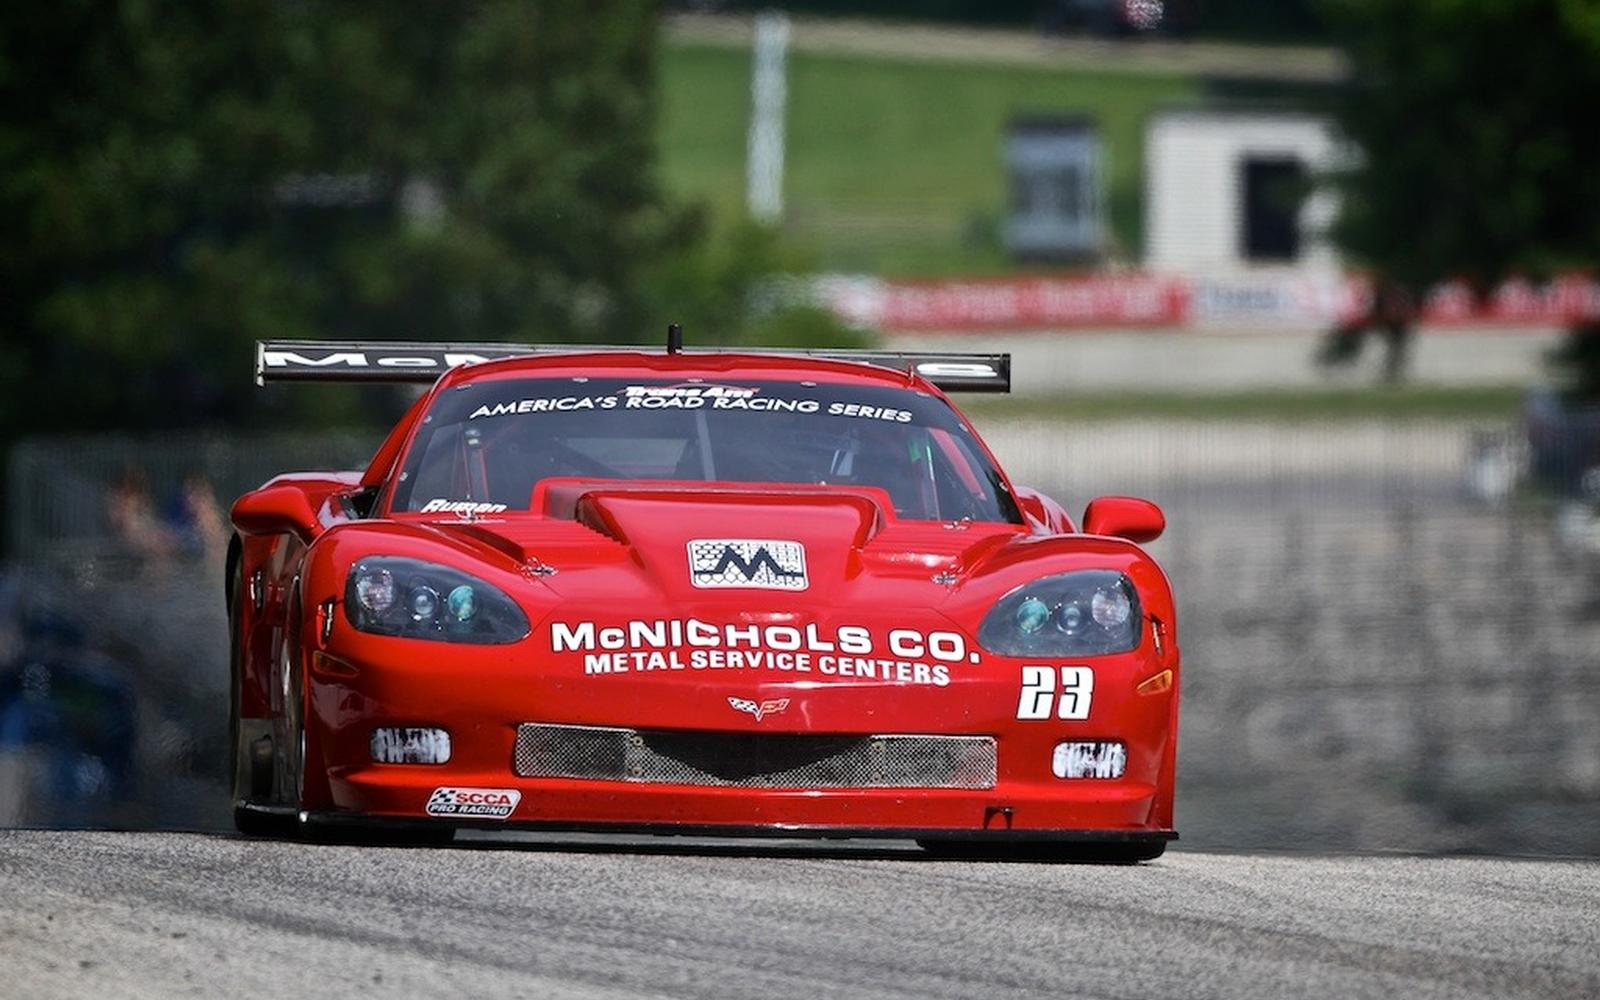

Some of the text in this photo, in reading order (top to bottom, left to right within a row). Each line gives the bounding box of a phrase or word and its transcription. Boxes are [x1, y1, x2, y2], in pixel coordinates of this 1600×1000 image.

[470, 396, 913, 422] AMERICA'S ROAD RACING SERIES
[551, 618, 980, 664] McNICHOLS CO.
[585, 650, 950, 686] METAL SERVICE CENTERS
[1016, 655, 1094, 720] 23
[430, 804, 509, 816] PRO RACING
[456, 793, 511, 805] SCCA
